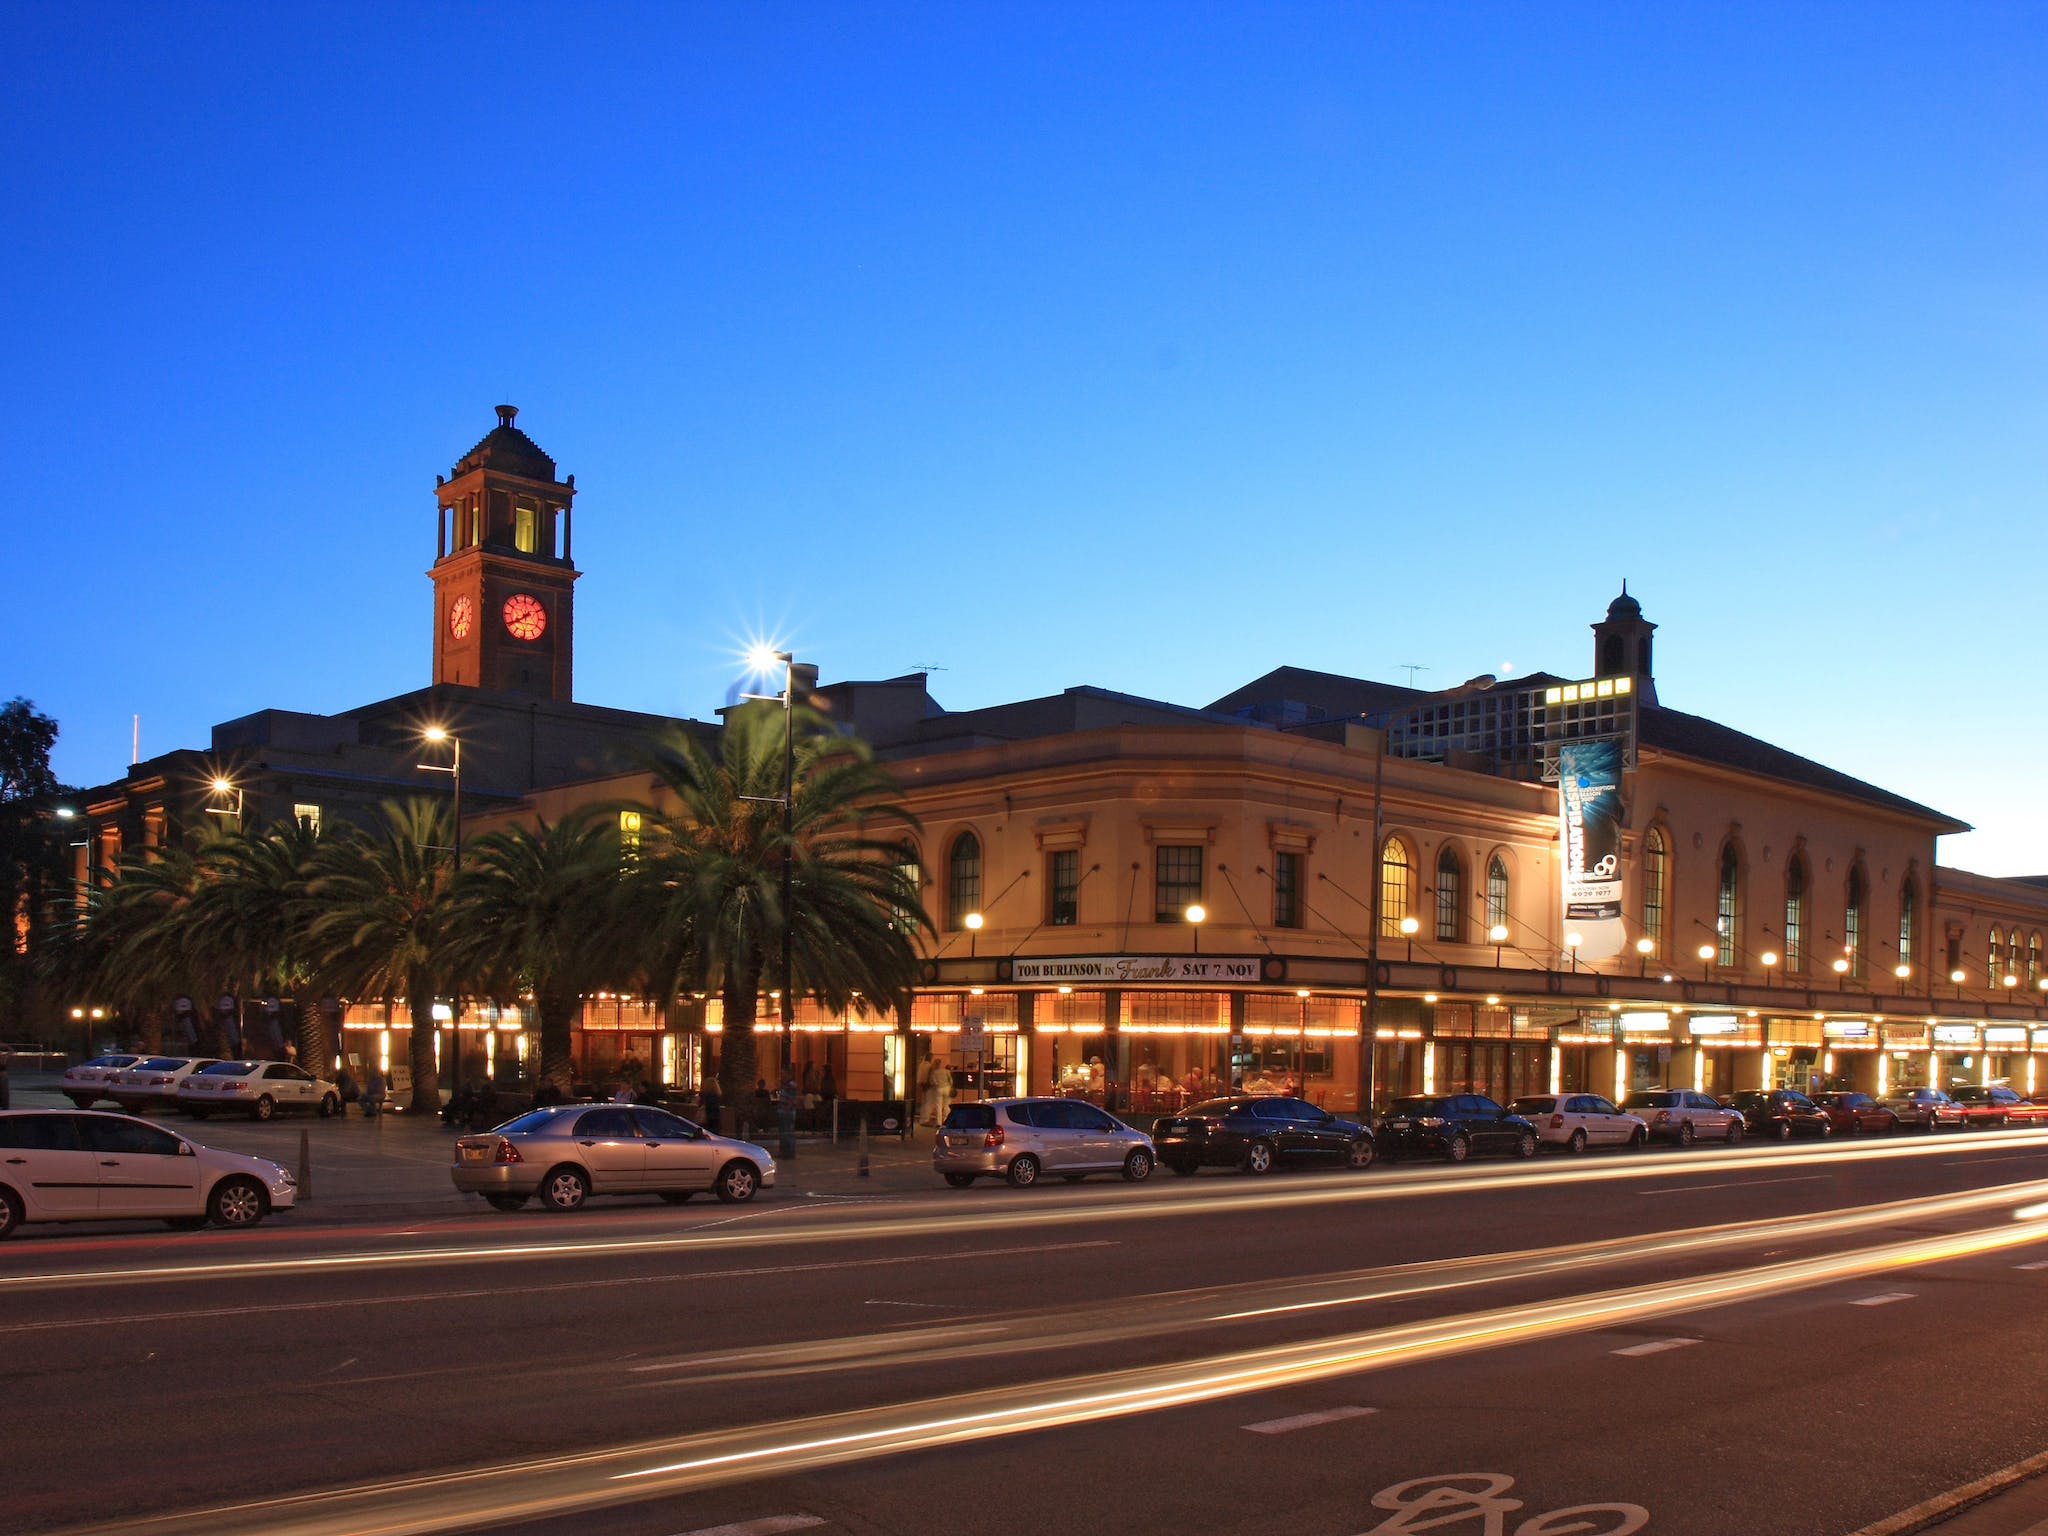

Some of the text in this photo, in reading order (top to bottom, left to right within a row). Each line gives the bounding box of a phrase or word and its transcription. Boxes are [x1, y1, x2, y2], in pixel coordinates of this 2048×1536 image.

[1018, 965, 1040, 976] TOM
[1043, 963, 1101, 976] BURLINSON
[1116, 958, 1176, 980] Frank
[1182, 964, 1208, 976] SAT
[1213, 964, 1222, 977] 7
[1226, 964, 1256, 976] NOV
